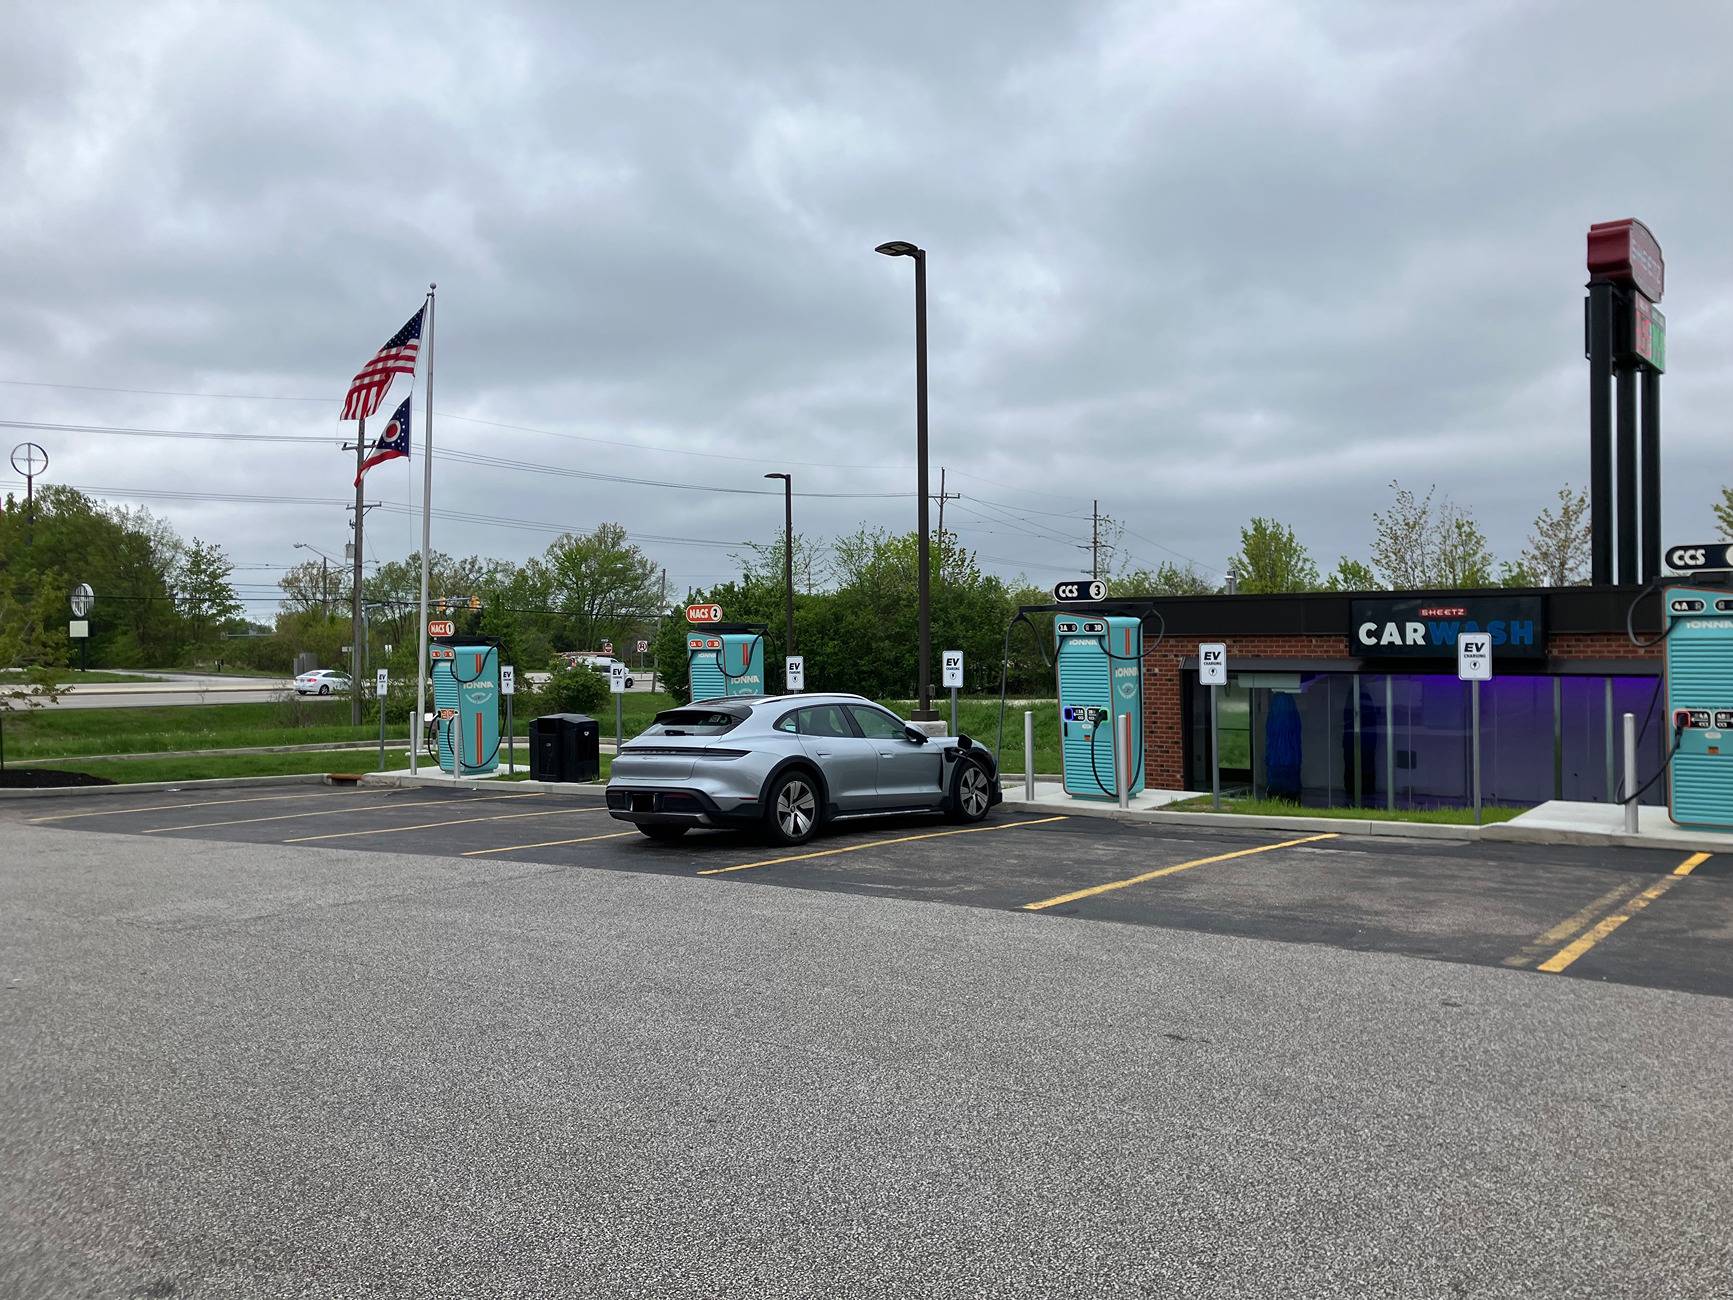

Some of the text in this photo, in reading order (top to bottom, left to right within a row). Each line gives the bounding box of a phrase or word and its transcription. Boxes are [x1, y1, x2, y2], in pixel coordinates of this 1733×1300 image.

[1672, 549, 1706, 566] CCS
[1058, 584, 1101, 598] CCS 3
[1674, 602, 1688, 610] 4A
[690, 608, 718, 618] NACS 2
[1421, 608, 1465, 616] SHEETZ
[430, 624, 445, 633] NACS
[1358, 622, 1426, 646] CAR
[1464, 642, 1485, 652] EV
[1204, 652, 1221, 660] EV
[946, 658, 960, 666] EV
